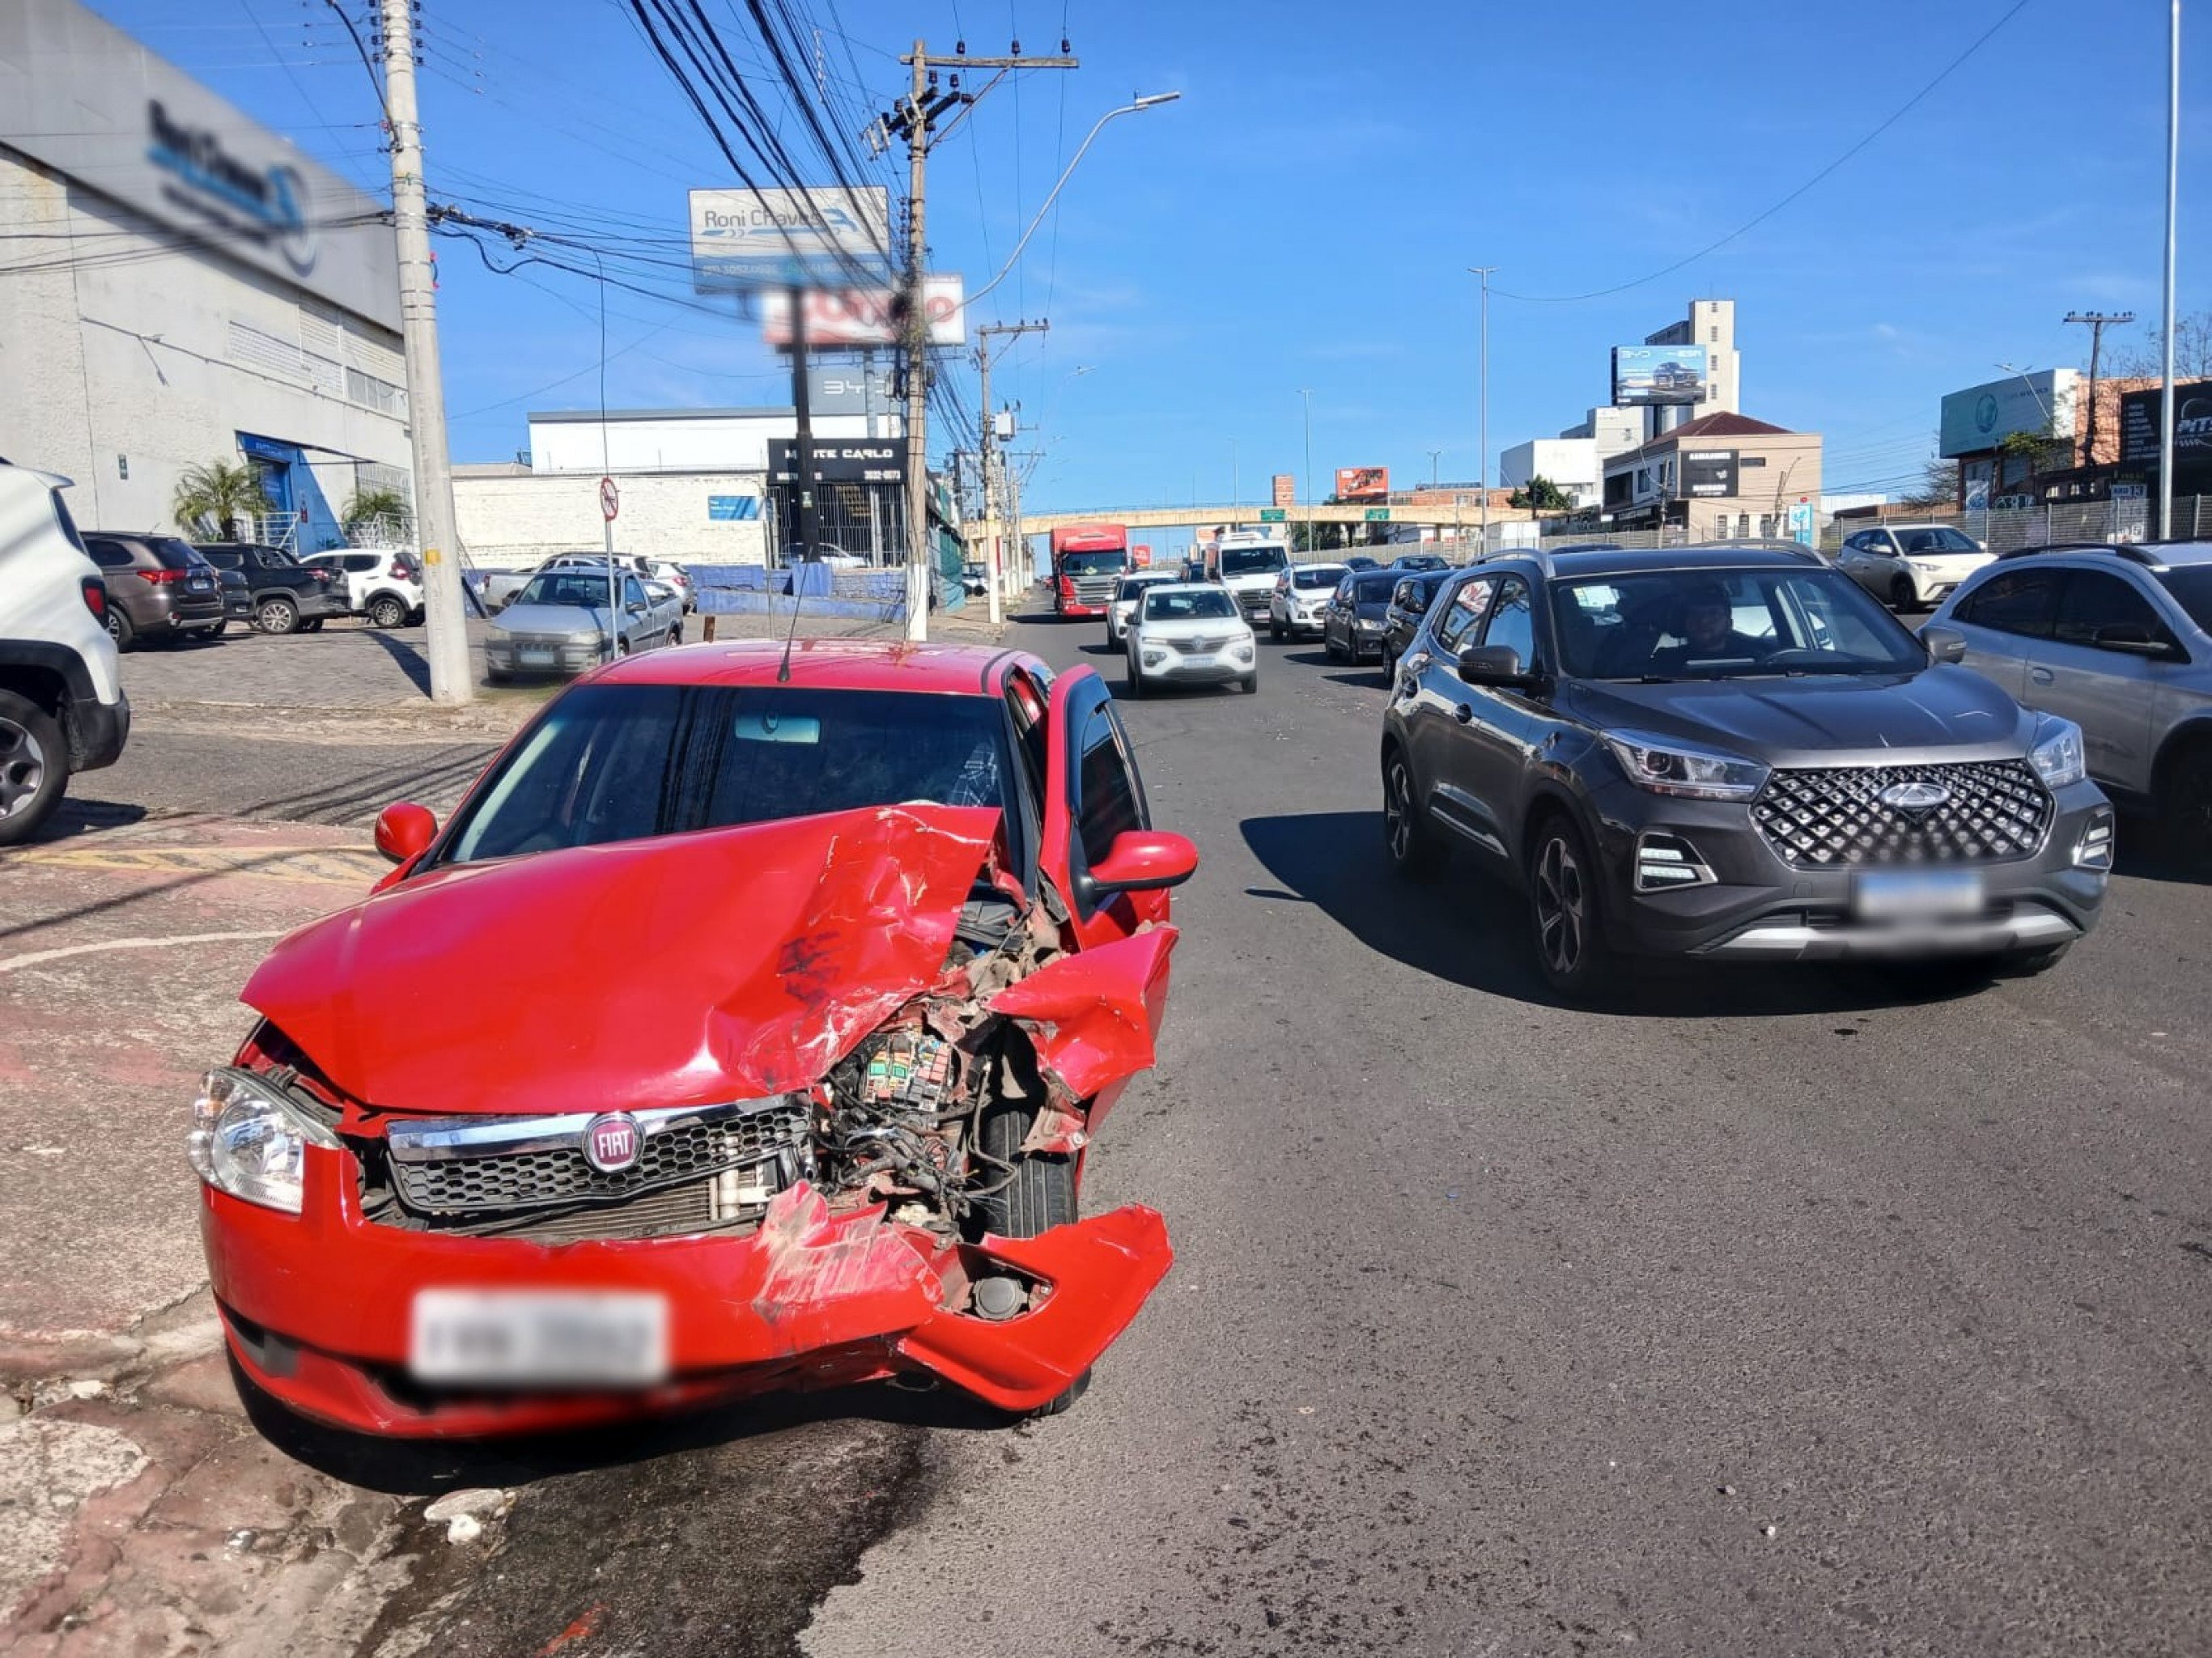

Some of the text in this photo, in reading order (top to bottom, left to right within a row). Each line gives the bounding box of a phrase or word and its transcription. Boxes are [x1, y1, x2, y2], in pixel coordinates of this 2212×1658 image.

[704, 209, 821, 227] Roni Chaves
[843, 448, 894, 460] CARLO
[598, 1130, 631, 1159] FIAT
